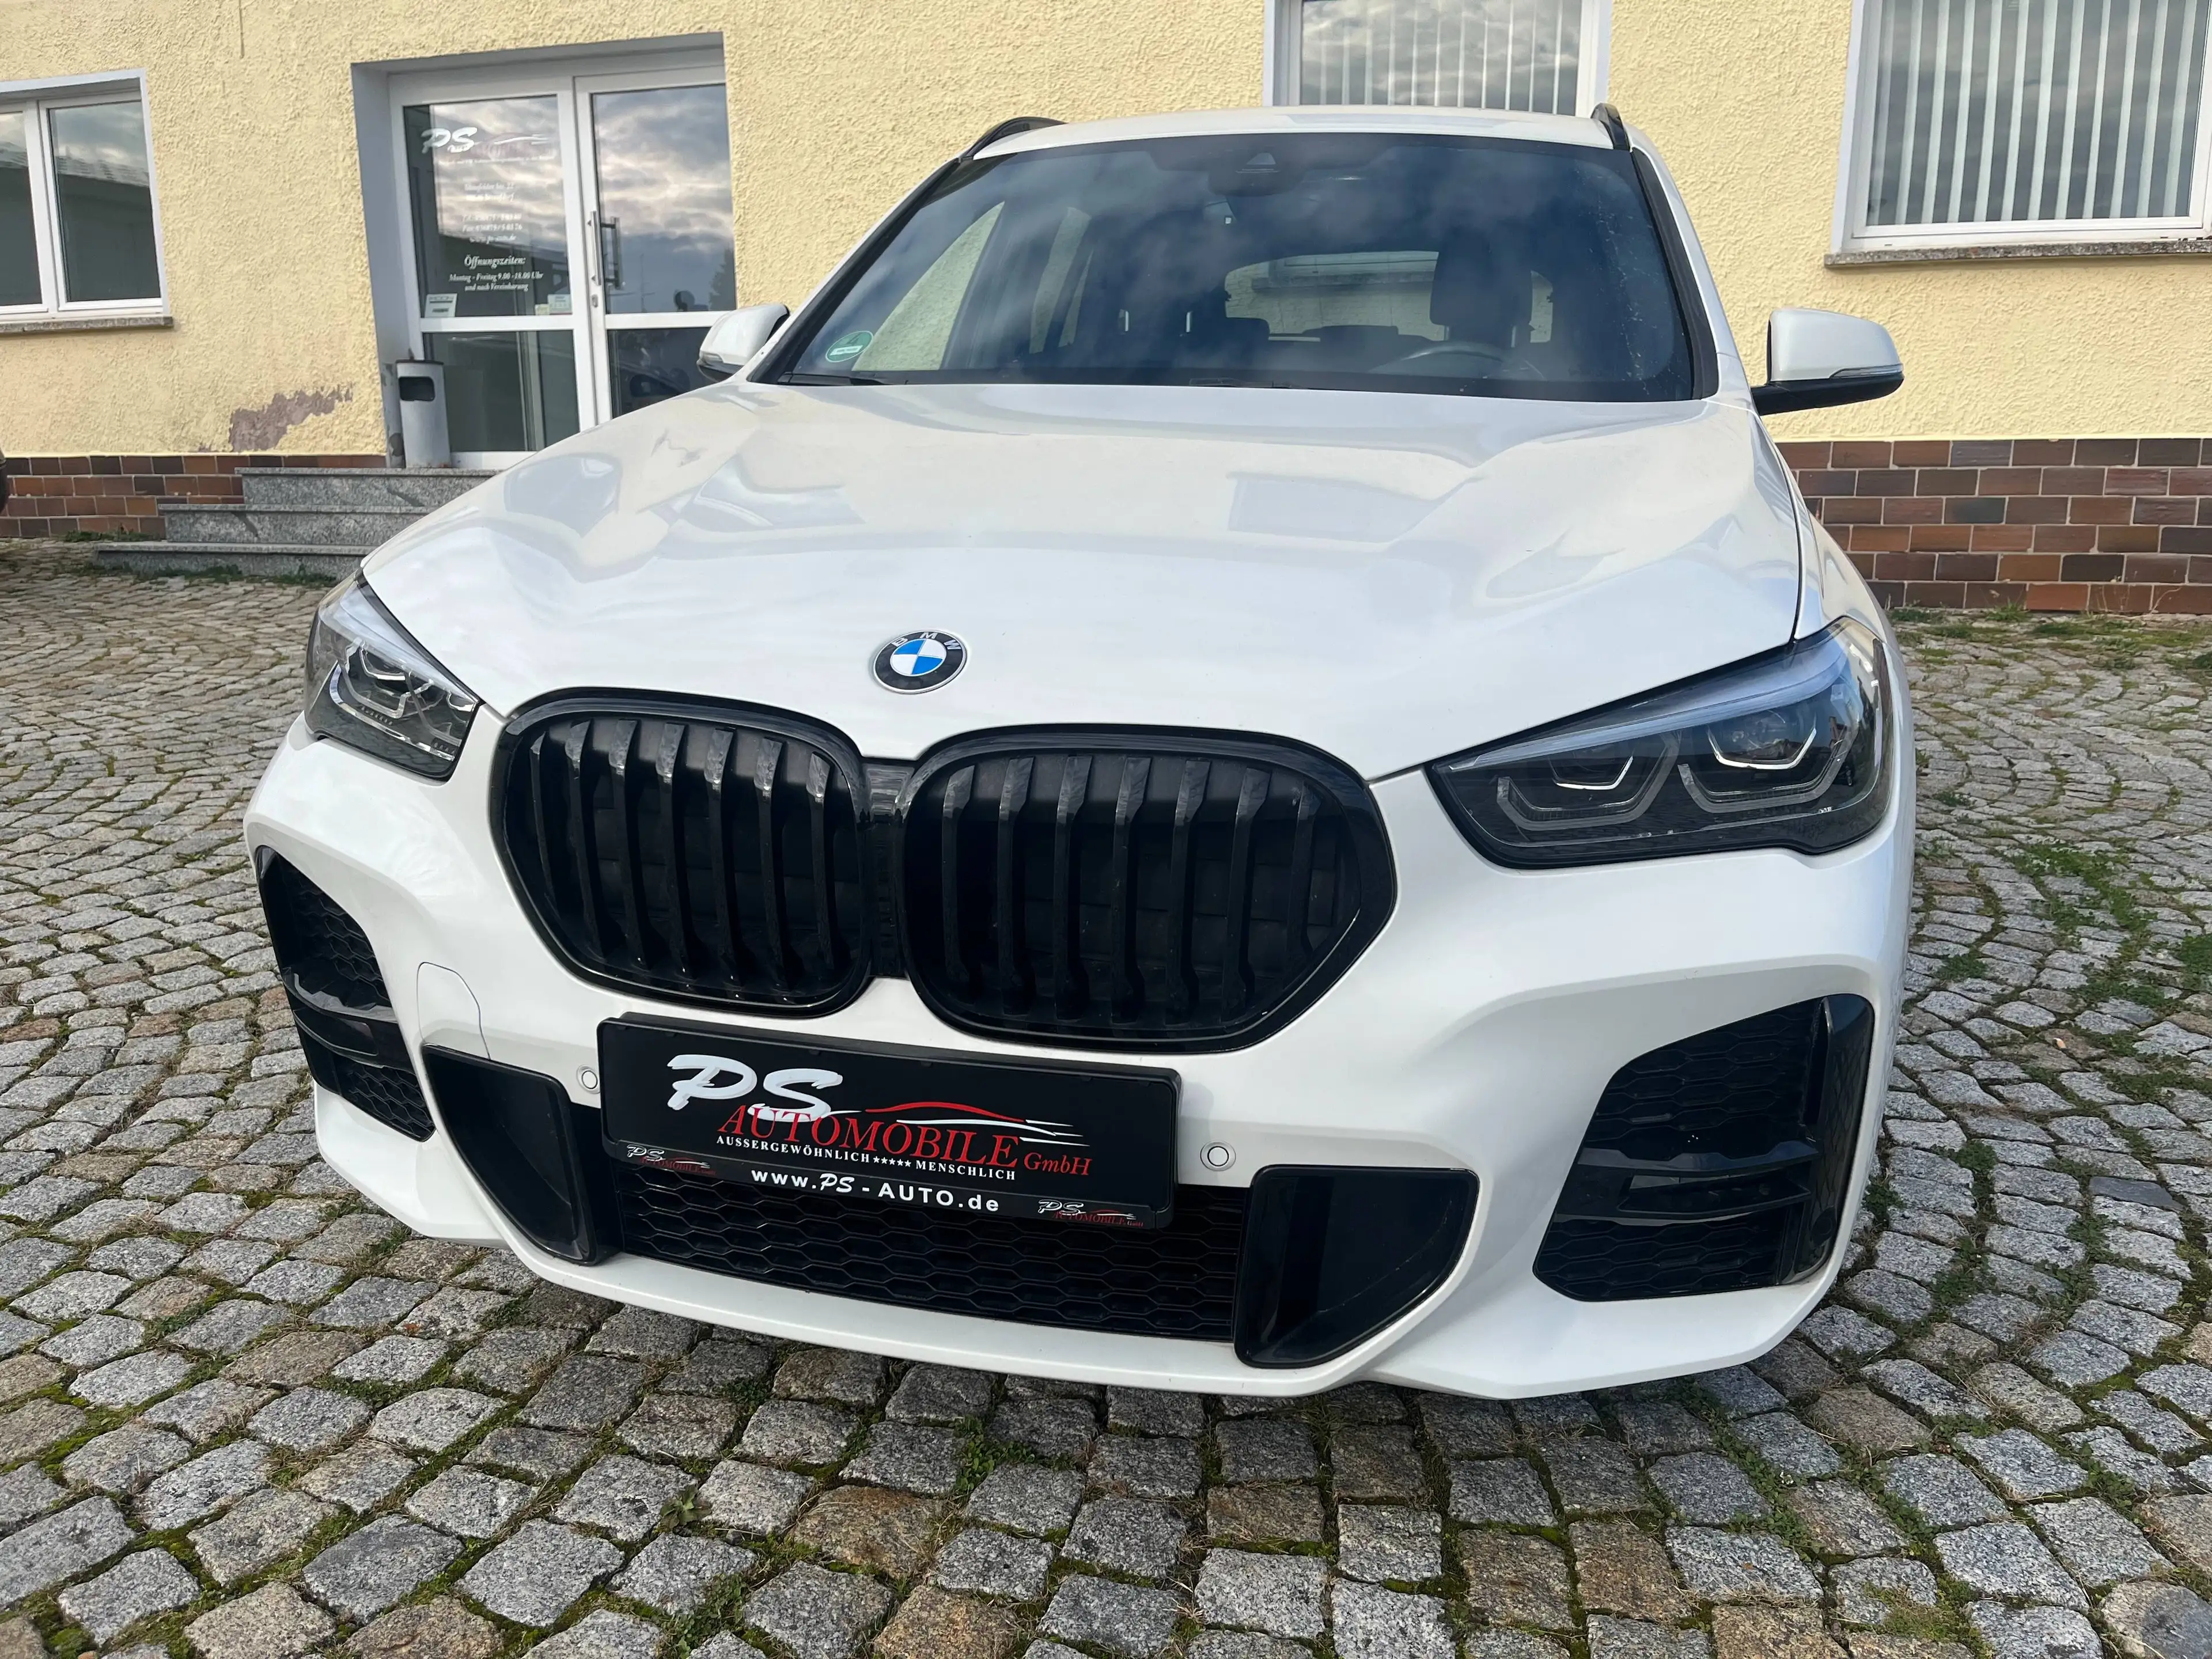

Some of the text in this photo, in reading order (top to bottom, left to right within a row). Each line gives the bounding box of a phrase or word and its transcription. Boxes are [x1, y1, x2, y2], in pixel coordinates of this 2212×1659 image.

[421, 127, 478, 154] PS
[464, 255, 526, 270] Öffnungszeiten:
[891, 631, 962, 650] BMW
[667, 1054, 843, 1123] PS
[717, 1104, 1093, 1176] AUTOMOBILE GmbH
[627, 1144, 665, 1161] PS
[717, 1135, 1016, 1180] AUSSERGEWÖHNLICH MENSCHLICH
[1038, 1199, 1084, 1216] PS
